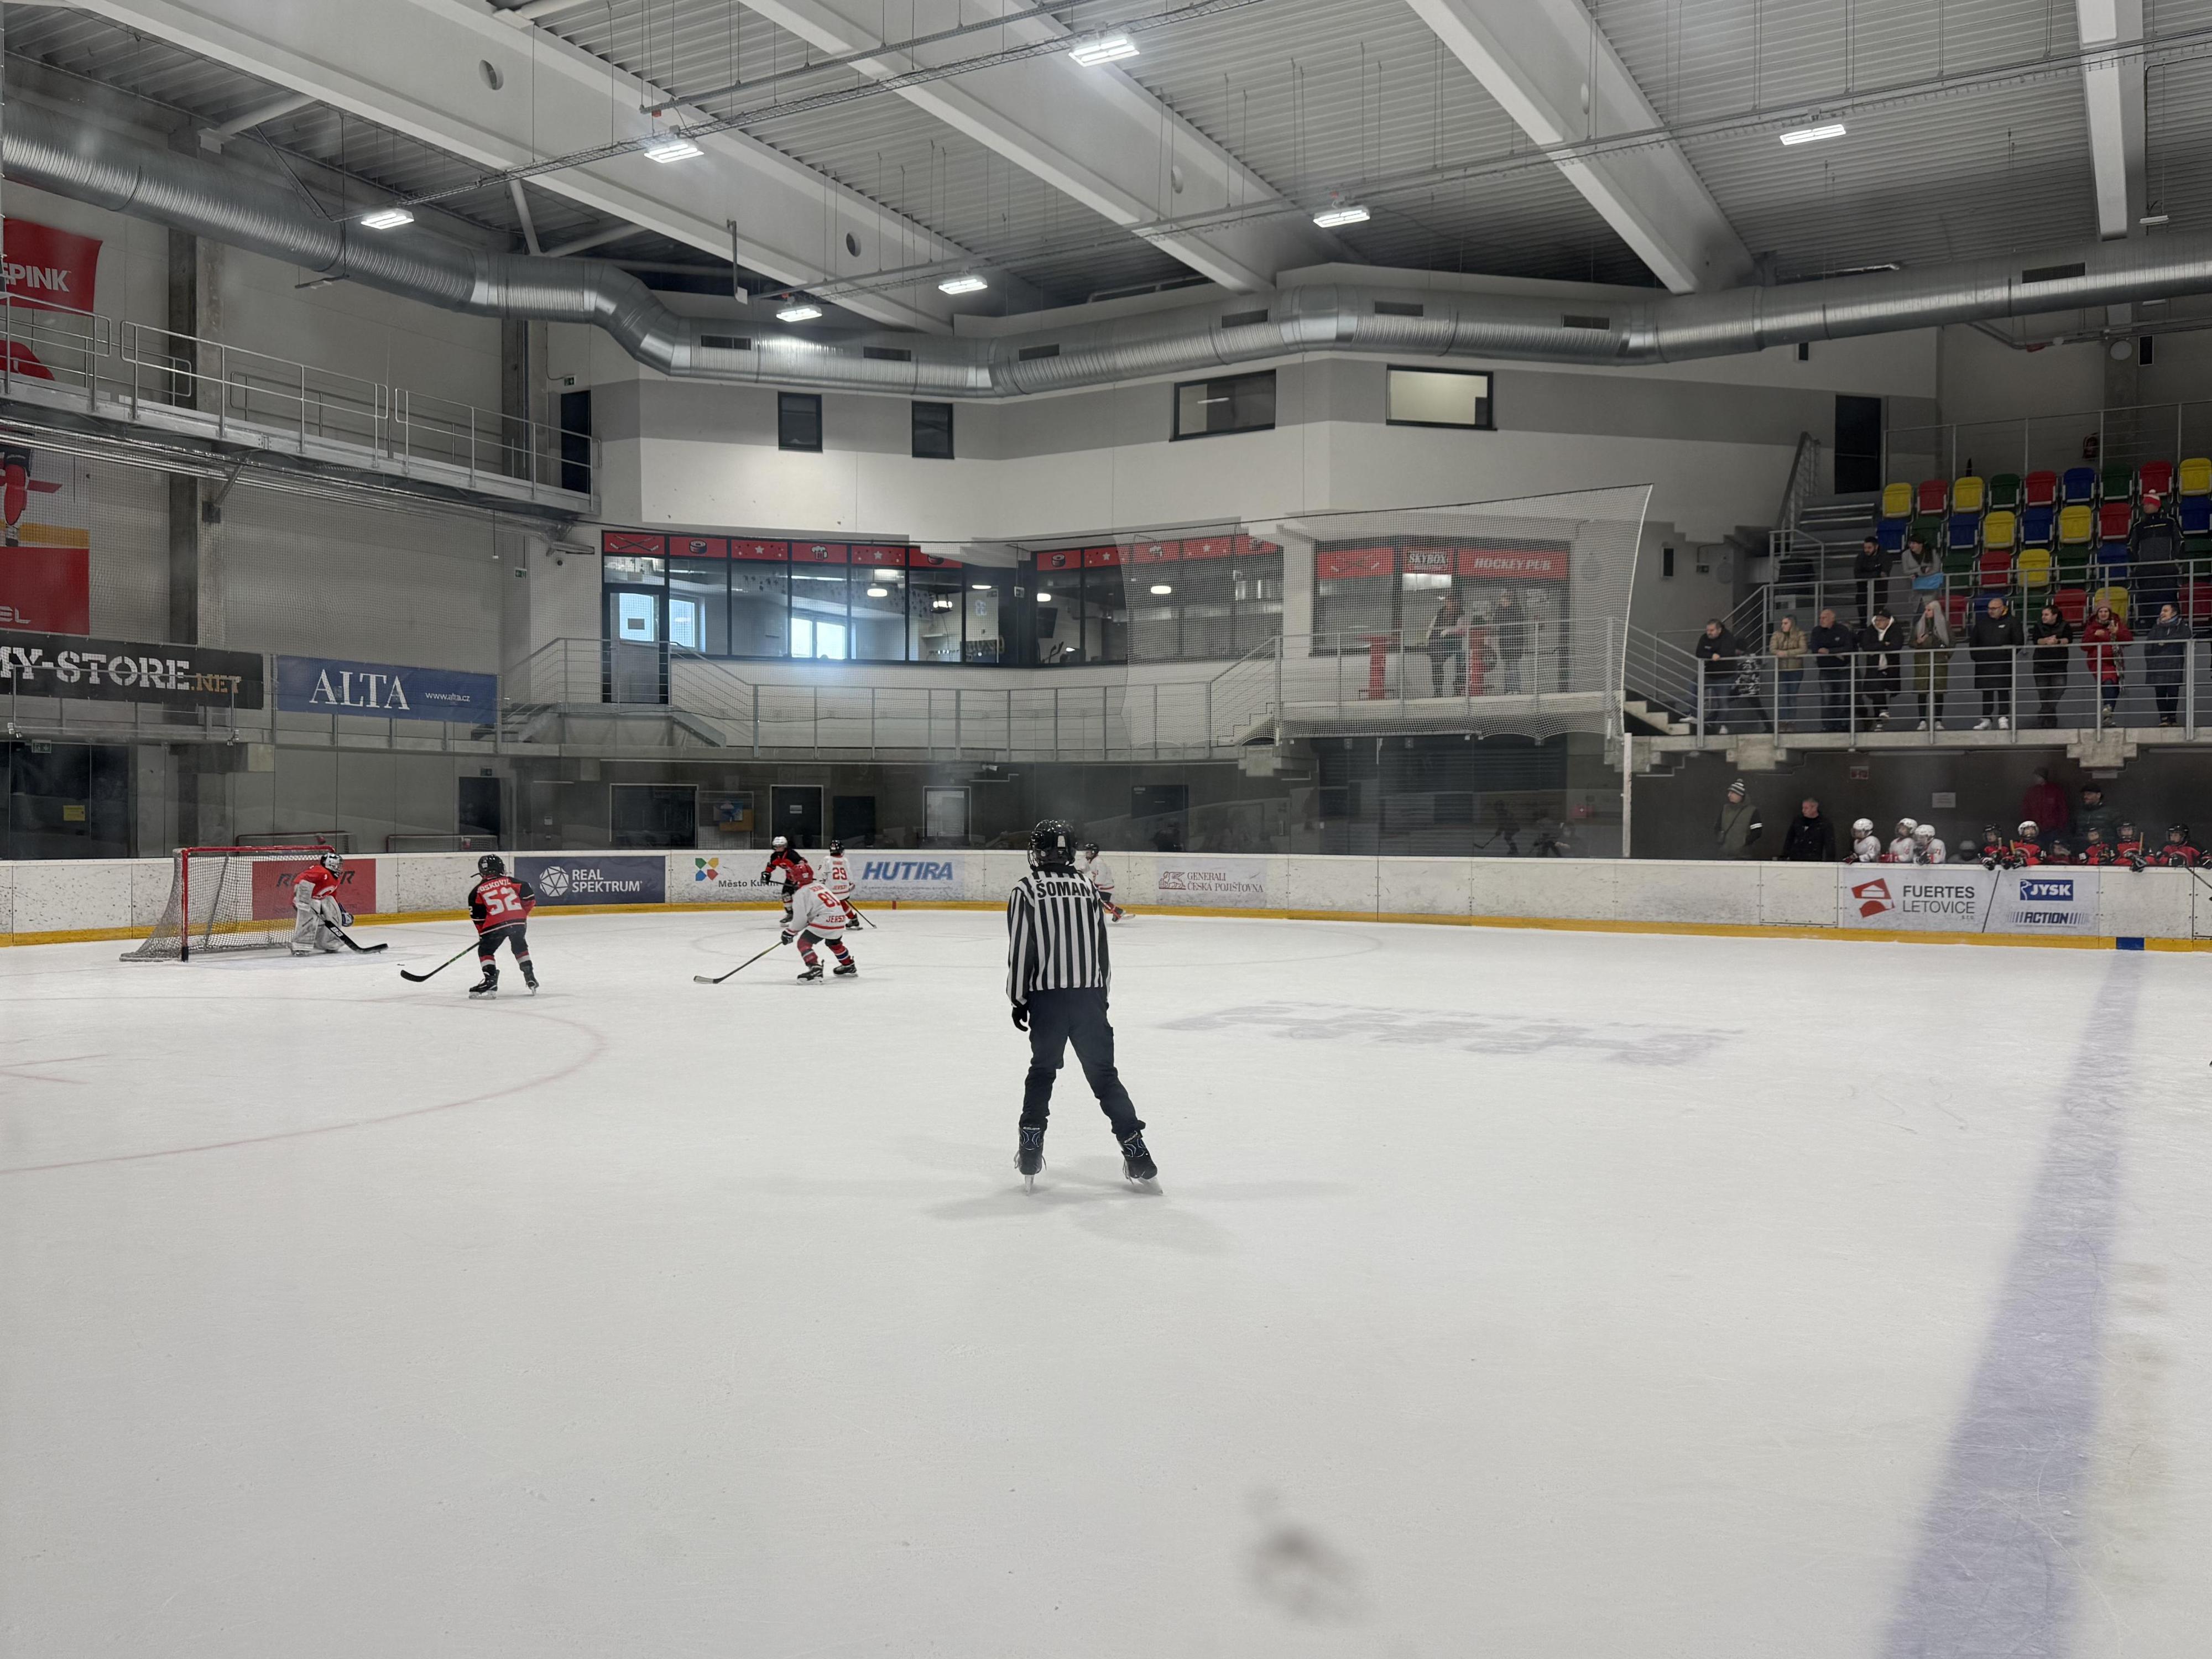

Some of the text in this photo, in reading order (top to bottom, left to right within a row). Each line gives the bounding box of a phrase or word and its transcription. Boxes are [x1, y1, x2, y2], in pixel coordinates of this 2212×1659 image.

[1474, 558, 1552, 570] HOCKEY PUB
[309, 669, 470, 710] ALTA www.alta.cz
[572, 869, 604, 880] REAL
[832, 867, 847, 880] 29
[862, 861, 953, 880] HUTIRA
[1187, 872, 1226, 881] GENERALI
[572, 880, 640, 892] SPEKTRUM
[718, 879, 748, 888] Město
[1036, 879, 1091, 898] ŠOMAN
[1187, 881, 1213, 891] ČESKÁ
[2030, 884, 2071, 896] JYSK
[1903, 885, 1975, 899] FUERTES
[482, 886, 523, 916] 52
[817, 891, 841, 907] 81
[1903, 900, 1975, 914] LETOVICE
[2023, 911, 2069, 924] ACTION
